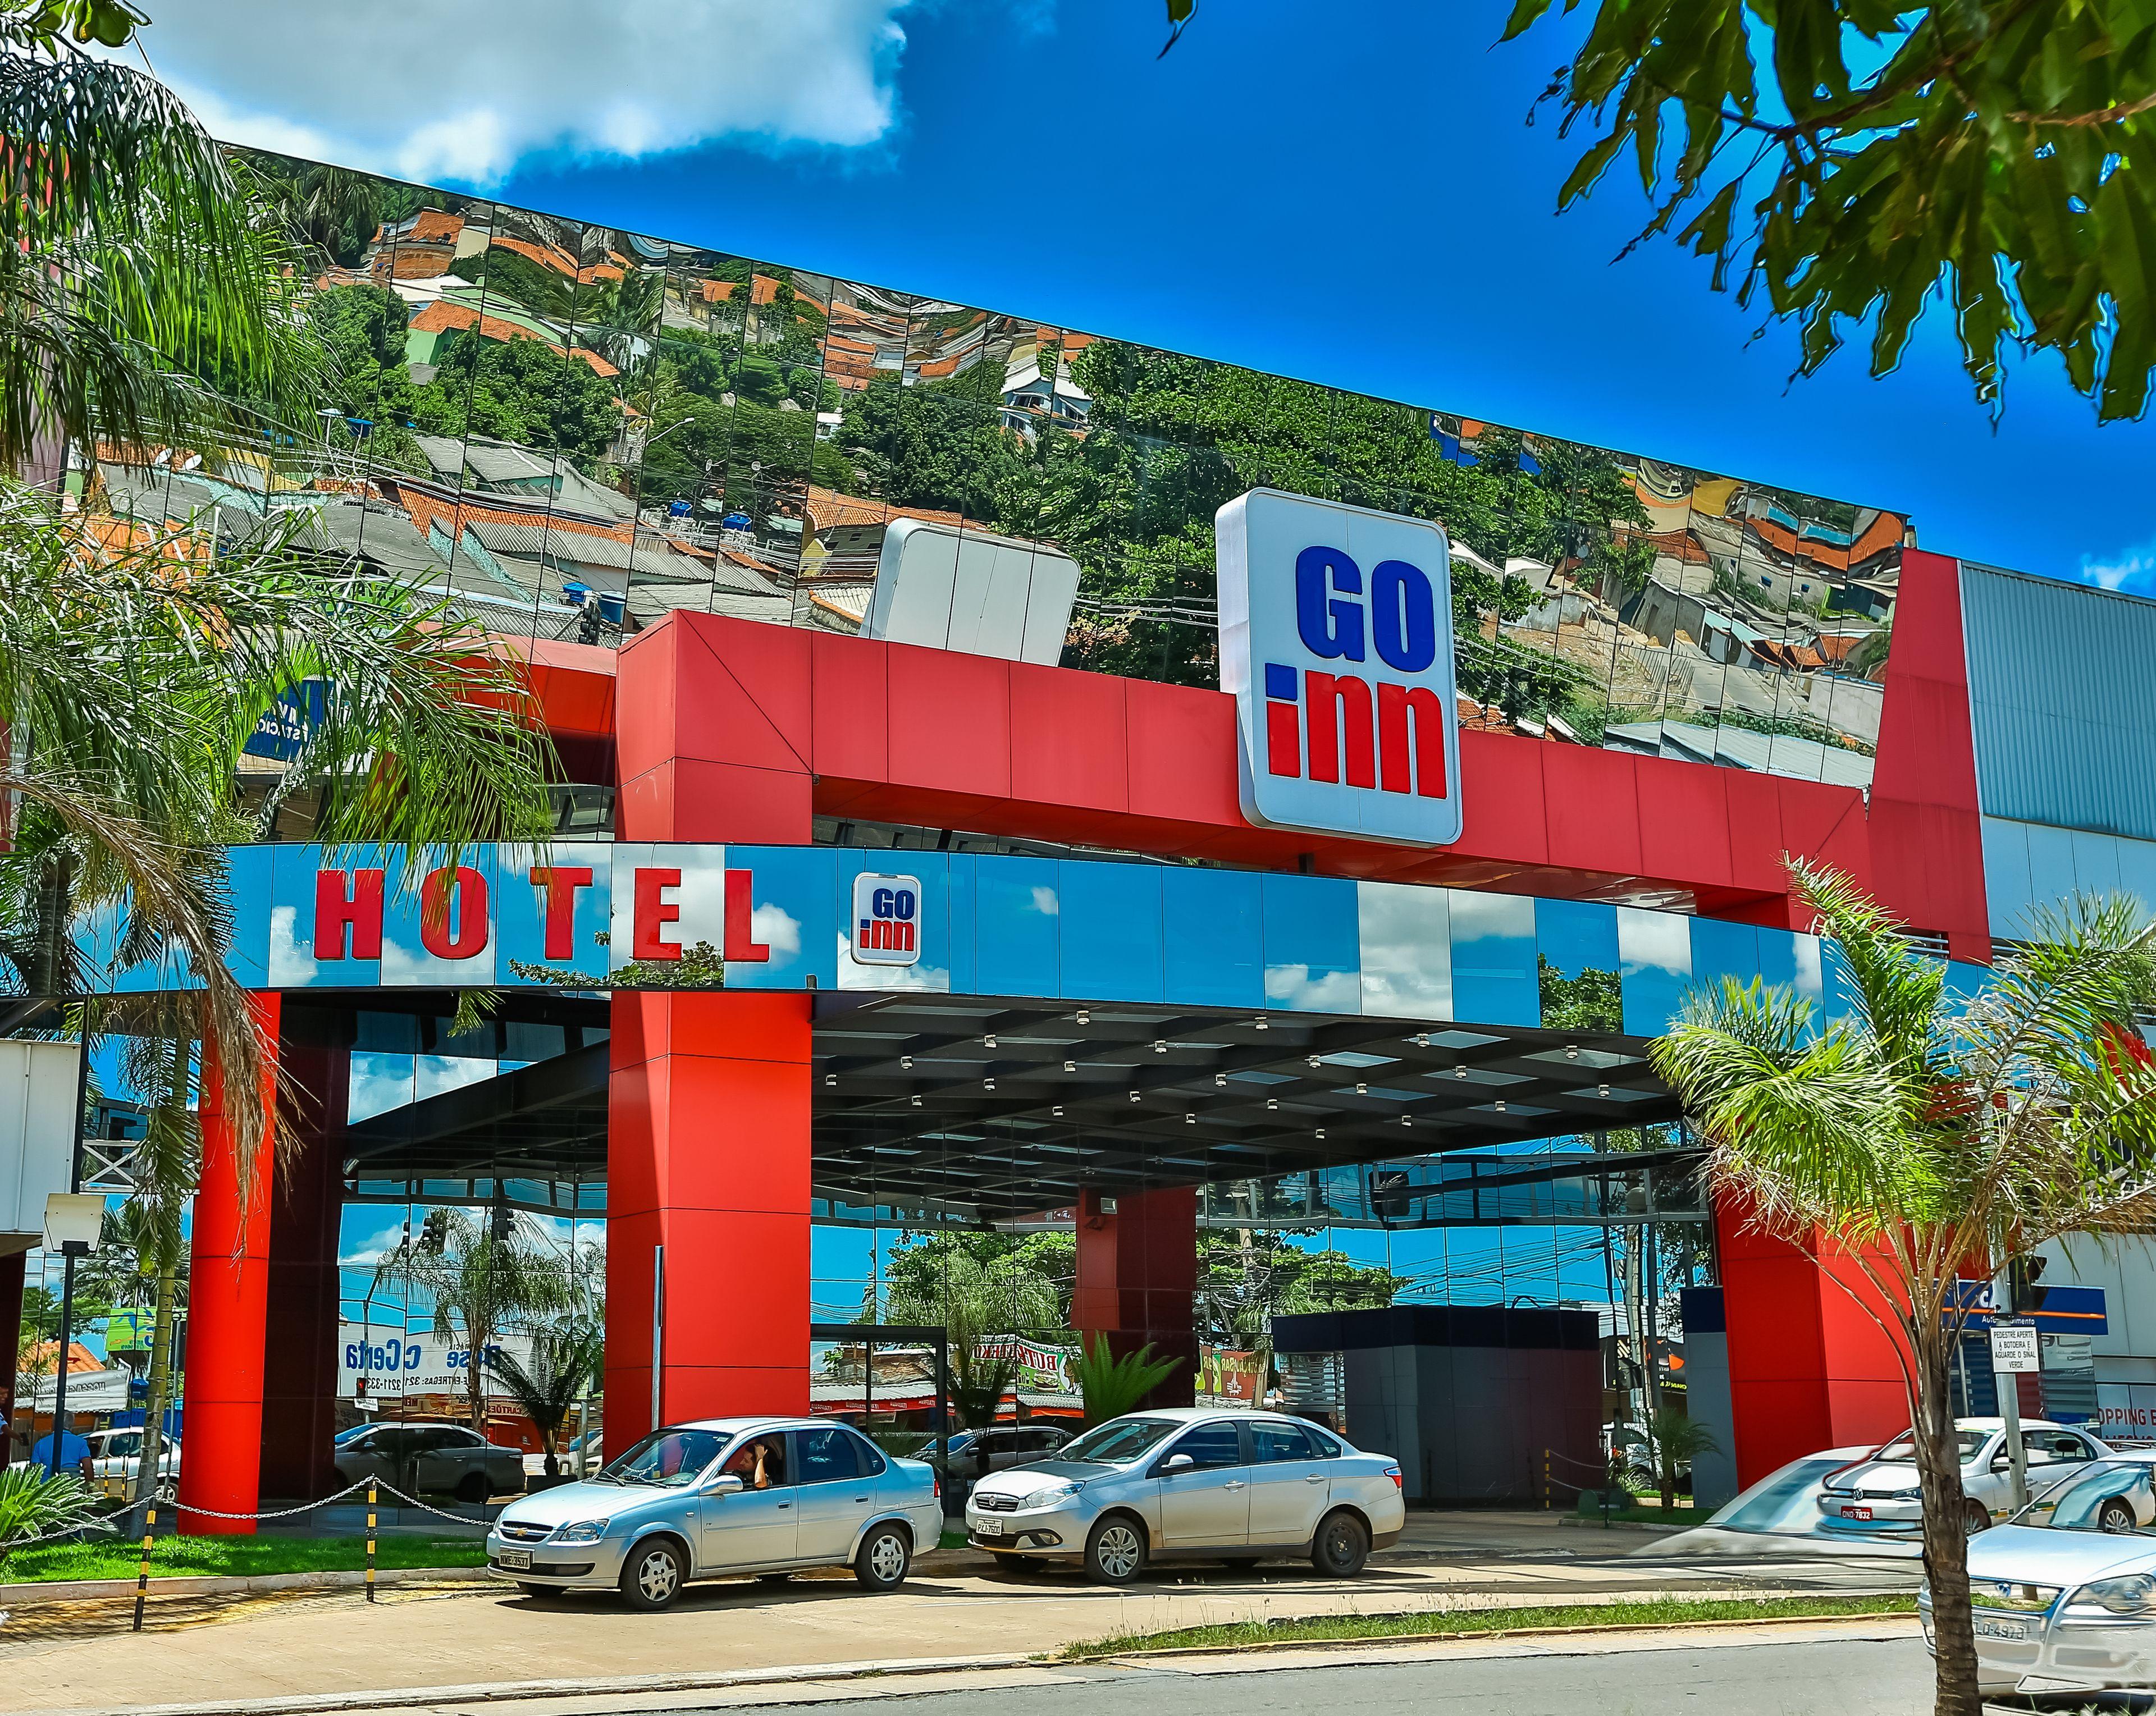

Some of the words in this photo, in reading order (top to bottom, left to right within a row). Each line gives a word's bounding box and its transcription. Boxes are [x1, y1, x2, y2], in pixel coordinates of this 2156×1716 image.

[1295, 545, 1436, 673] GO
[1264, 662, 1447, 800] inn
[313, 866, 771, 962] HOTEL
[859, 918, 915, 953] inn
[872, 887, 915, 920] GO
